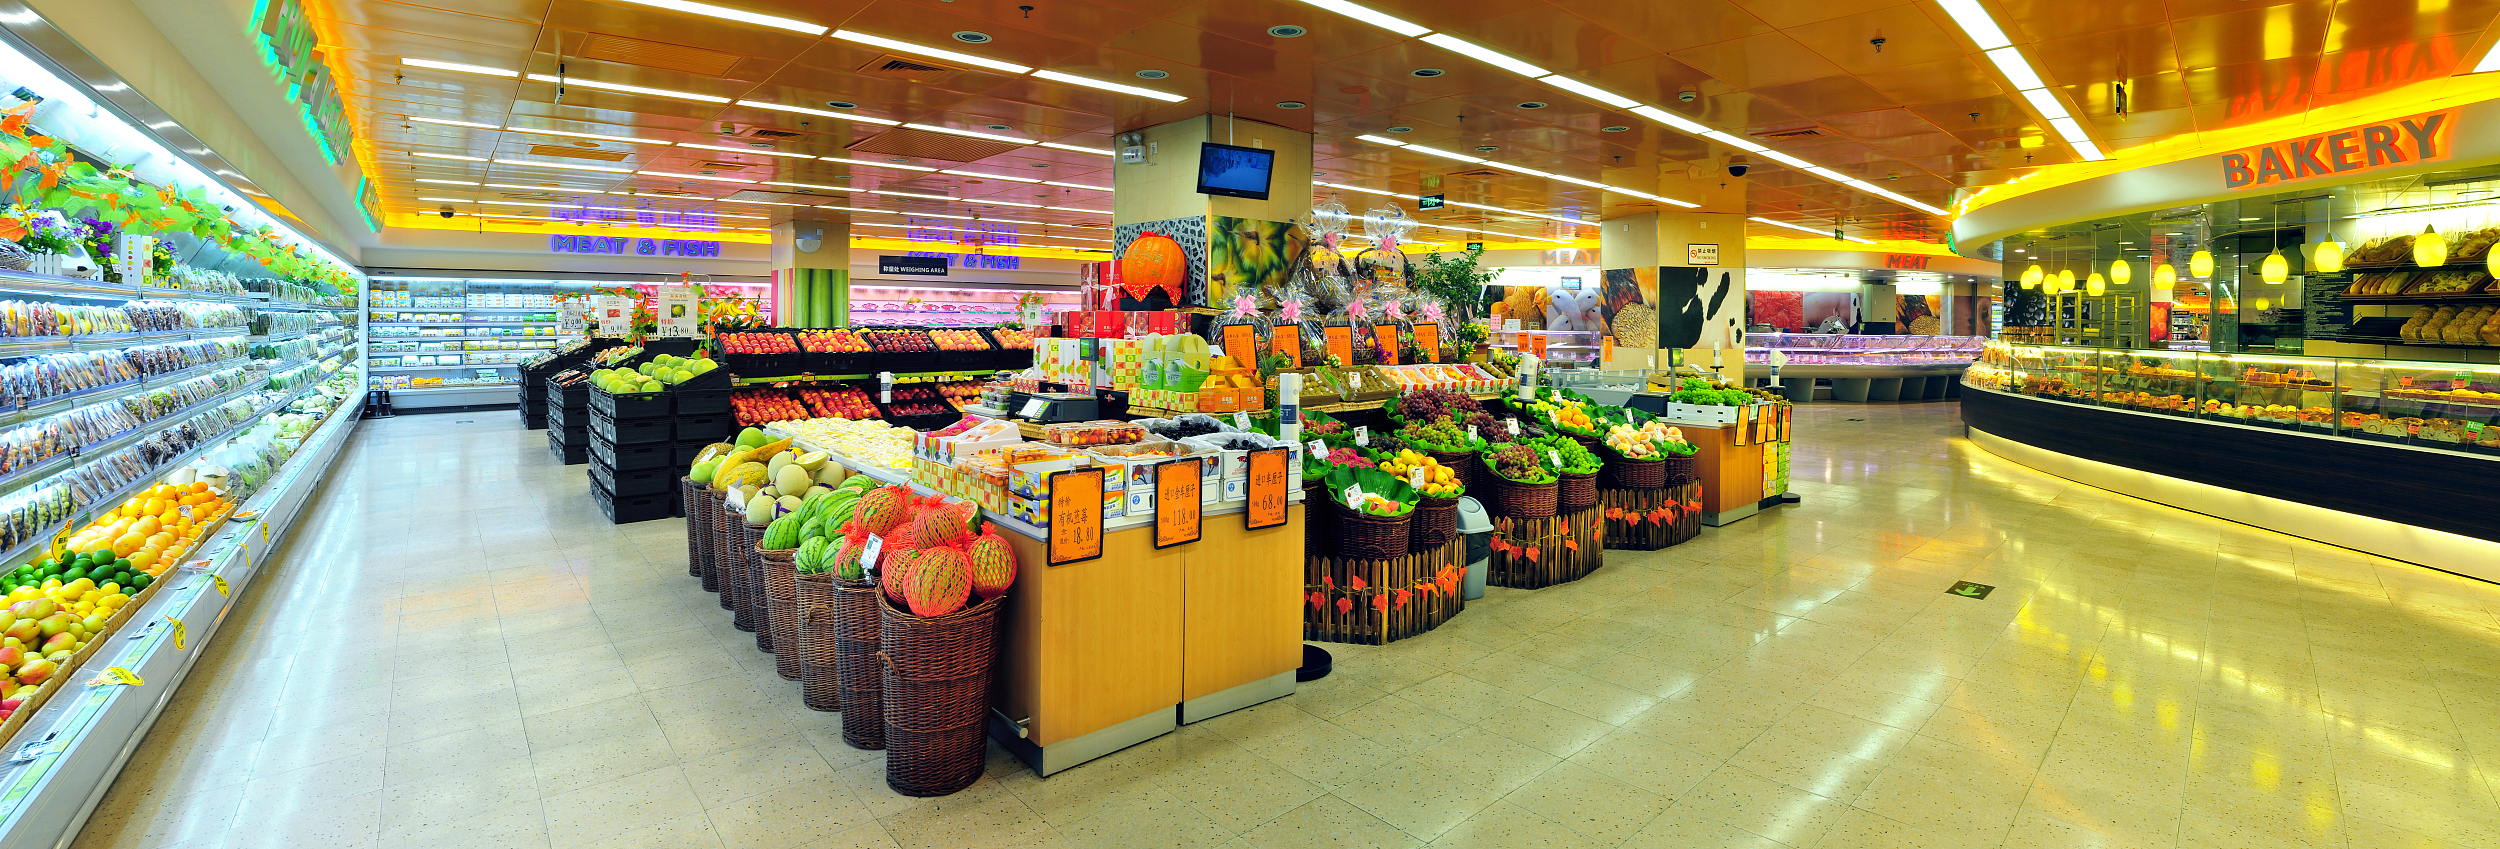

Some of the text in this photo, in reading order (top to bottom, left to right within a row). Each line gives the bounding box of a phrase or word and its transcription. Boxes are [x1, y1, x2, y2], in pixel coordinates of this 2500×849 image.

[2222, 113, 2447, 189] BAKERY
[552, 235, 719, 258] MEAT & FISH
[982, 255, 1020, 269] FISH
[1542, 250, 1599, 264] MEAT
[1886, 254, 1932, 270] MEAT
[1255, 471, 1283, 487] 进口车厘子
